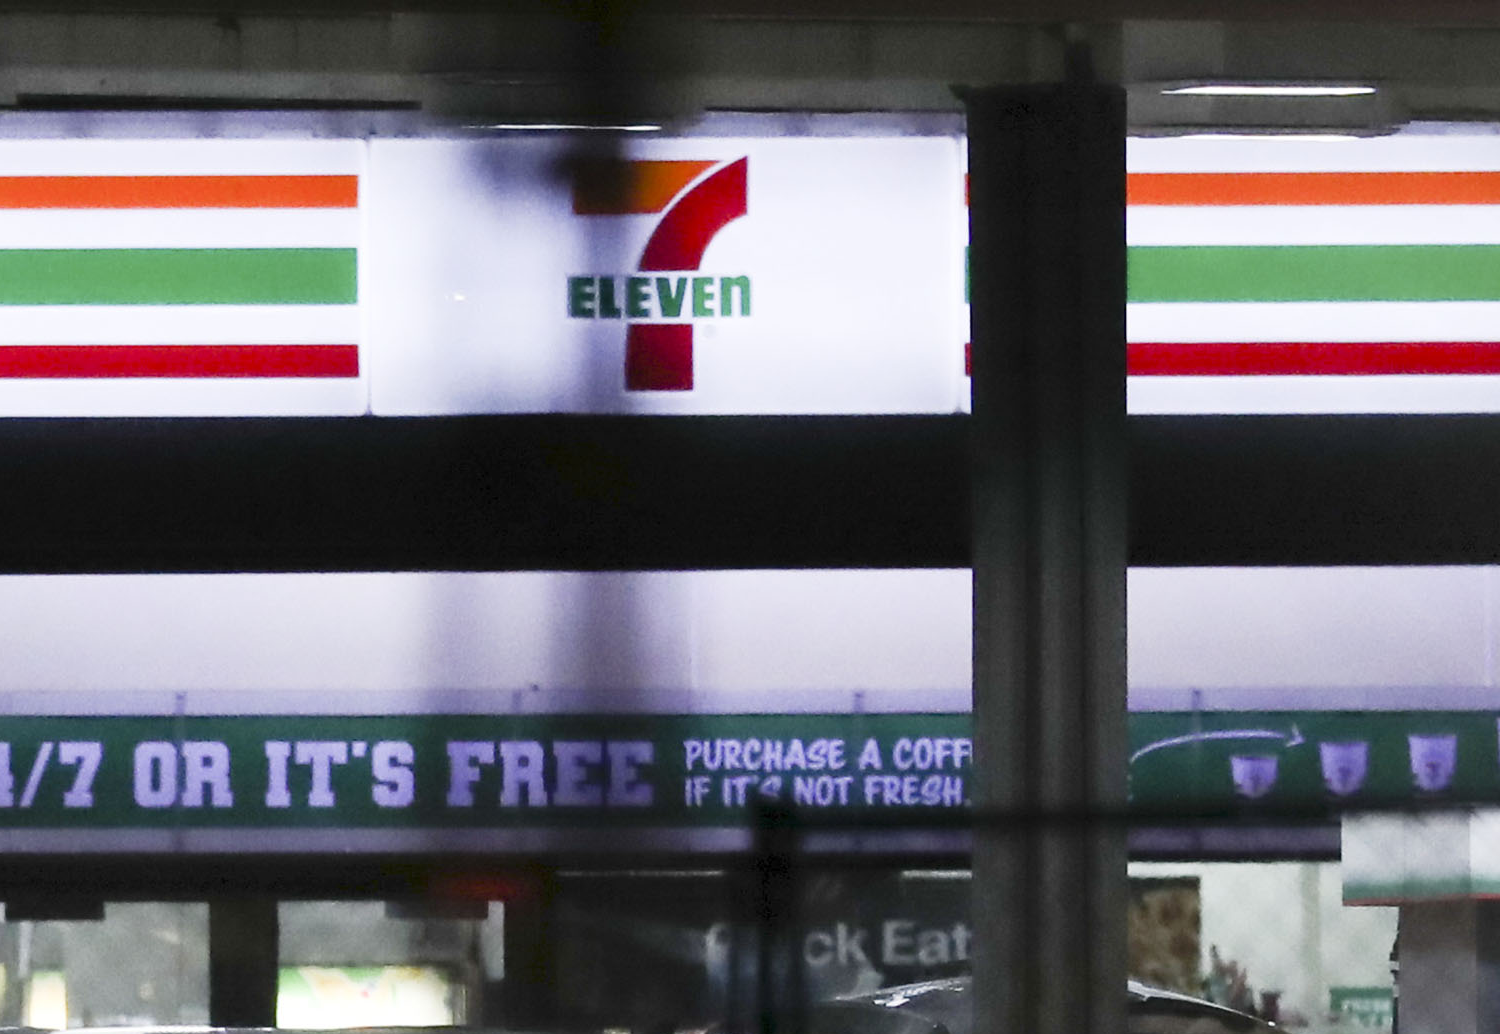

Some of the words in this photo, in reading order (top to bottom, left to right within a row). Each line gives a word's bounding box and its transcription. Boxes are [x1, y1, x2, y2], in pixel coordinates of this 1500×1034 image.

[572, 156, 748, 391] 7
[133, 741, 233, 807] OR
[264, 741, 415, 807] IT'S
[446, 741, 655, 808] FREE
[683, 738, 846, 771] PURCHASE
[858, 738, 883, 771] A
[893, 738, 972, 771] COFF
[684, 776, 710, 806] IF
[722, 775, 783, 806] IT'S
[794, 776, 853, 806] NOT
